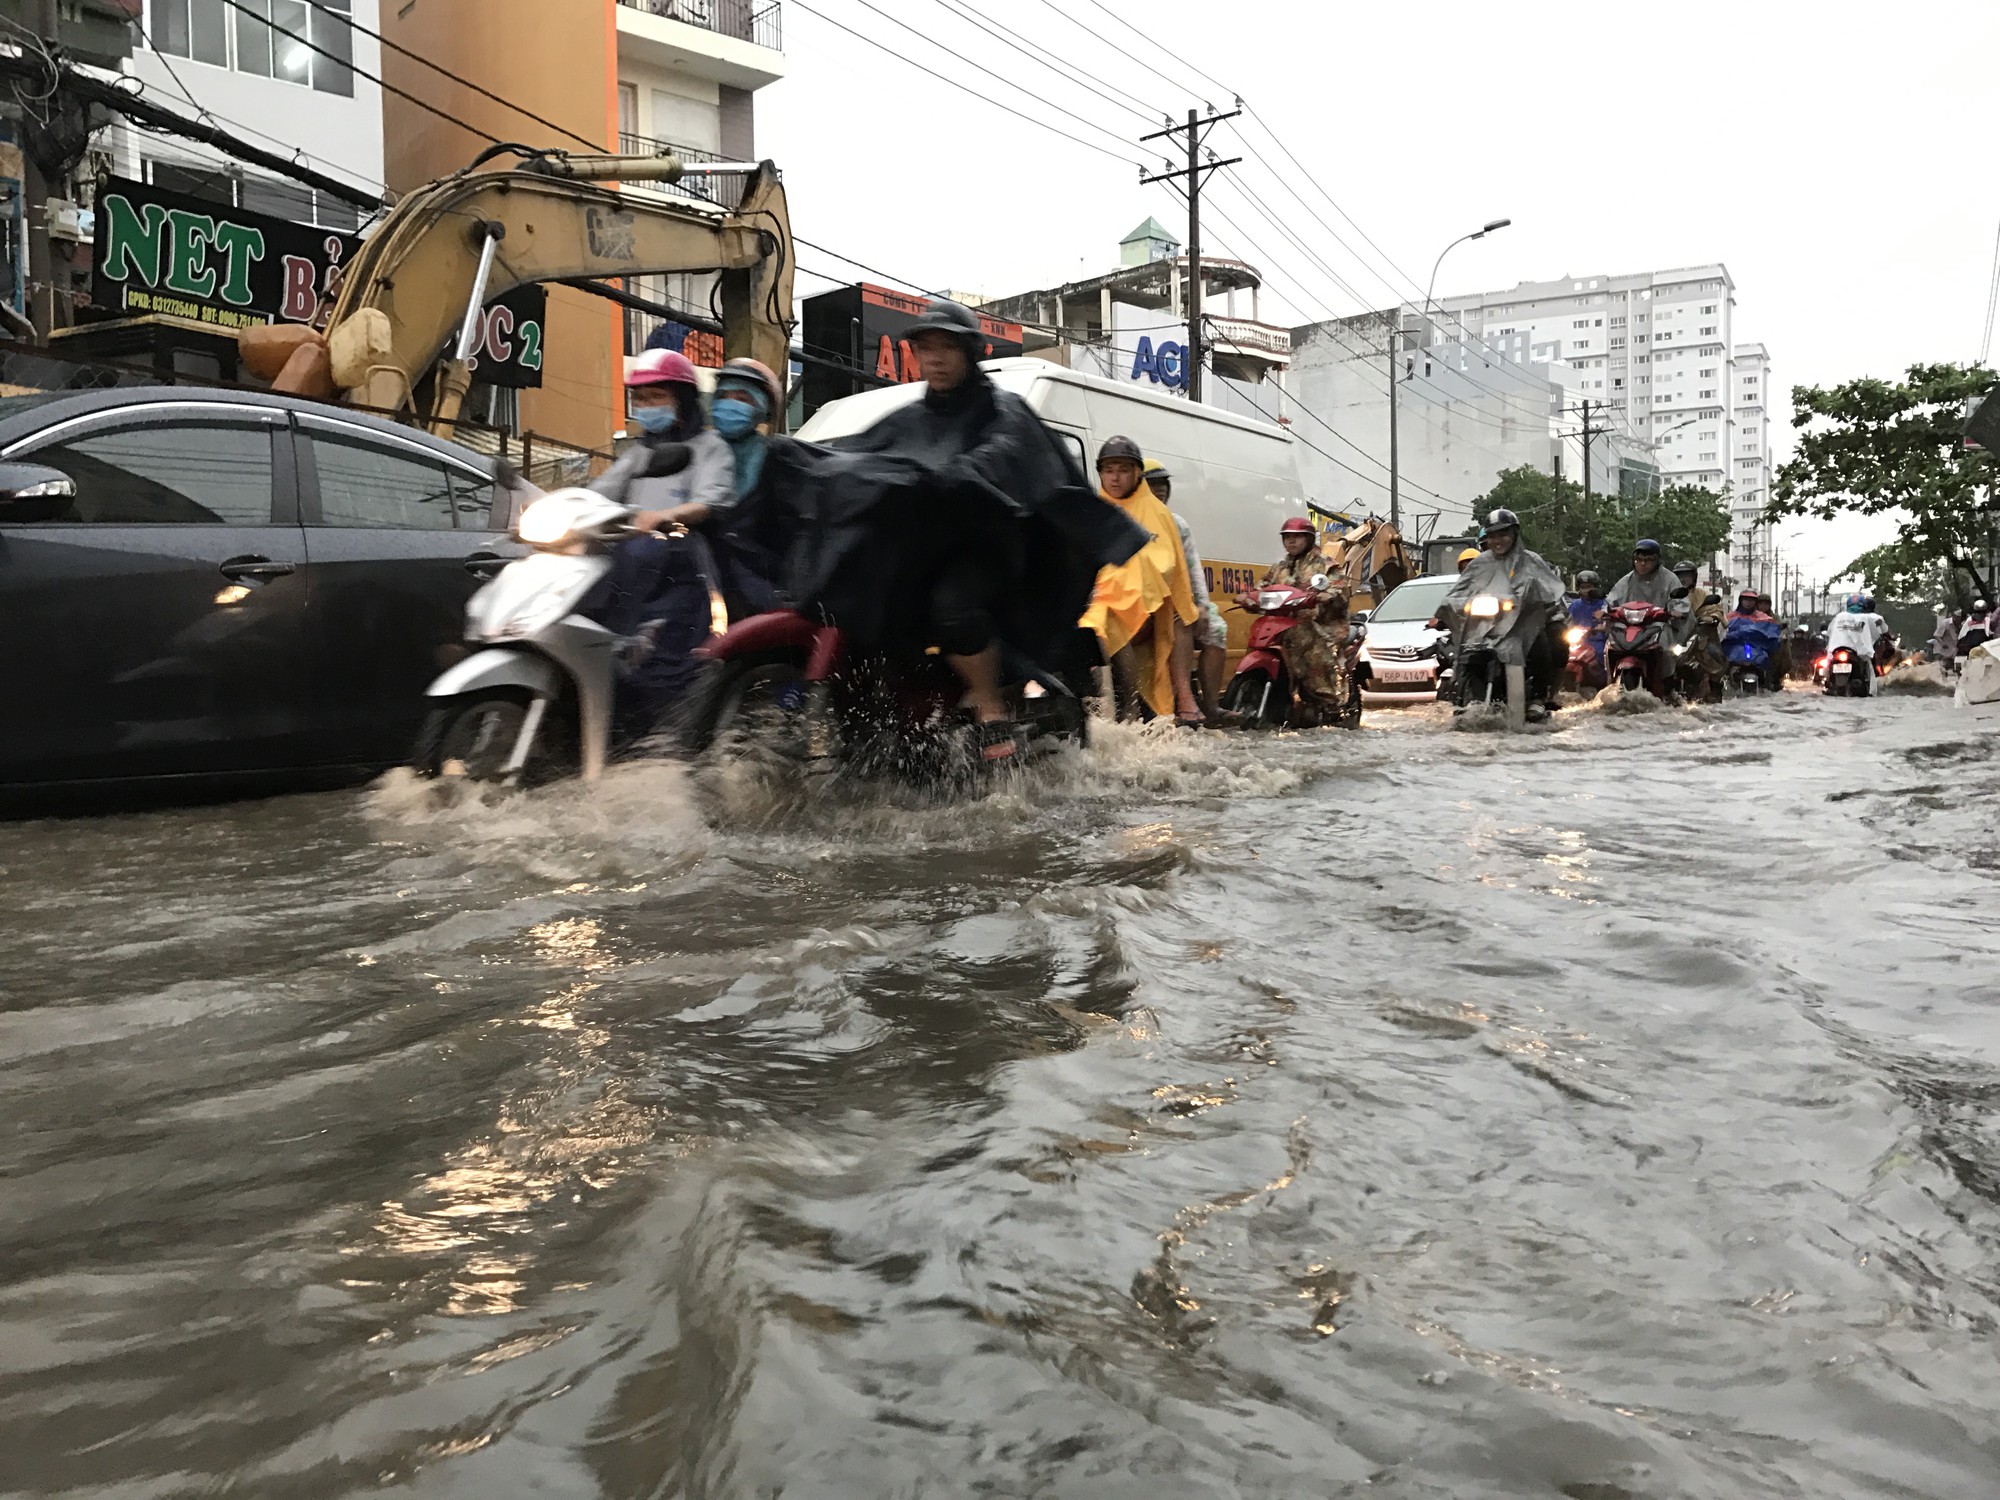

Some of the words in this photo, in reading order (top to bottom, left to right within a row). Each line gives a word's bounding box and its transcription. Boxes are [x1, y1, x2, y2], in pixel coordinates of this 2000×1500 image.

[102, 194, 265, 306] NET
[281, 235, 345, 328] BẢ
[518, 320, 542, 371] 2
